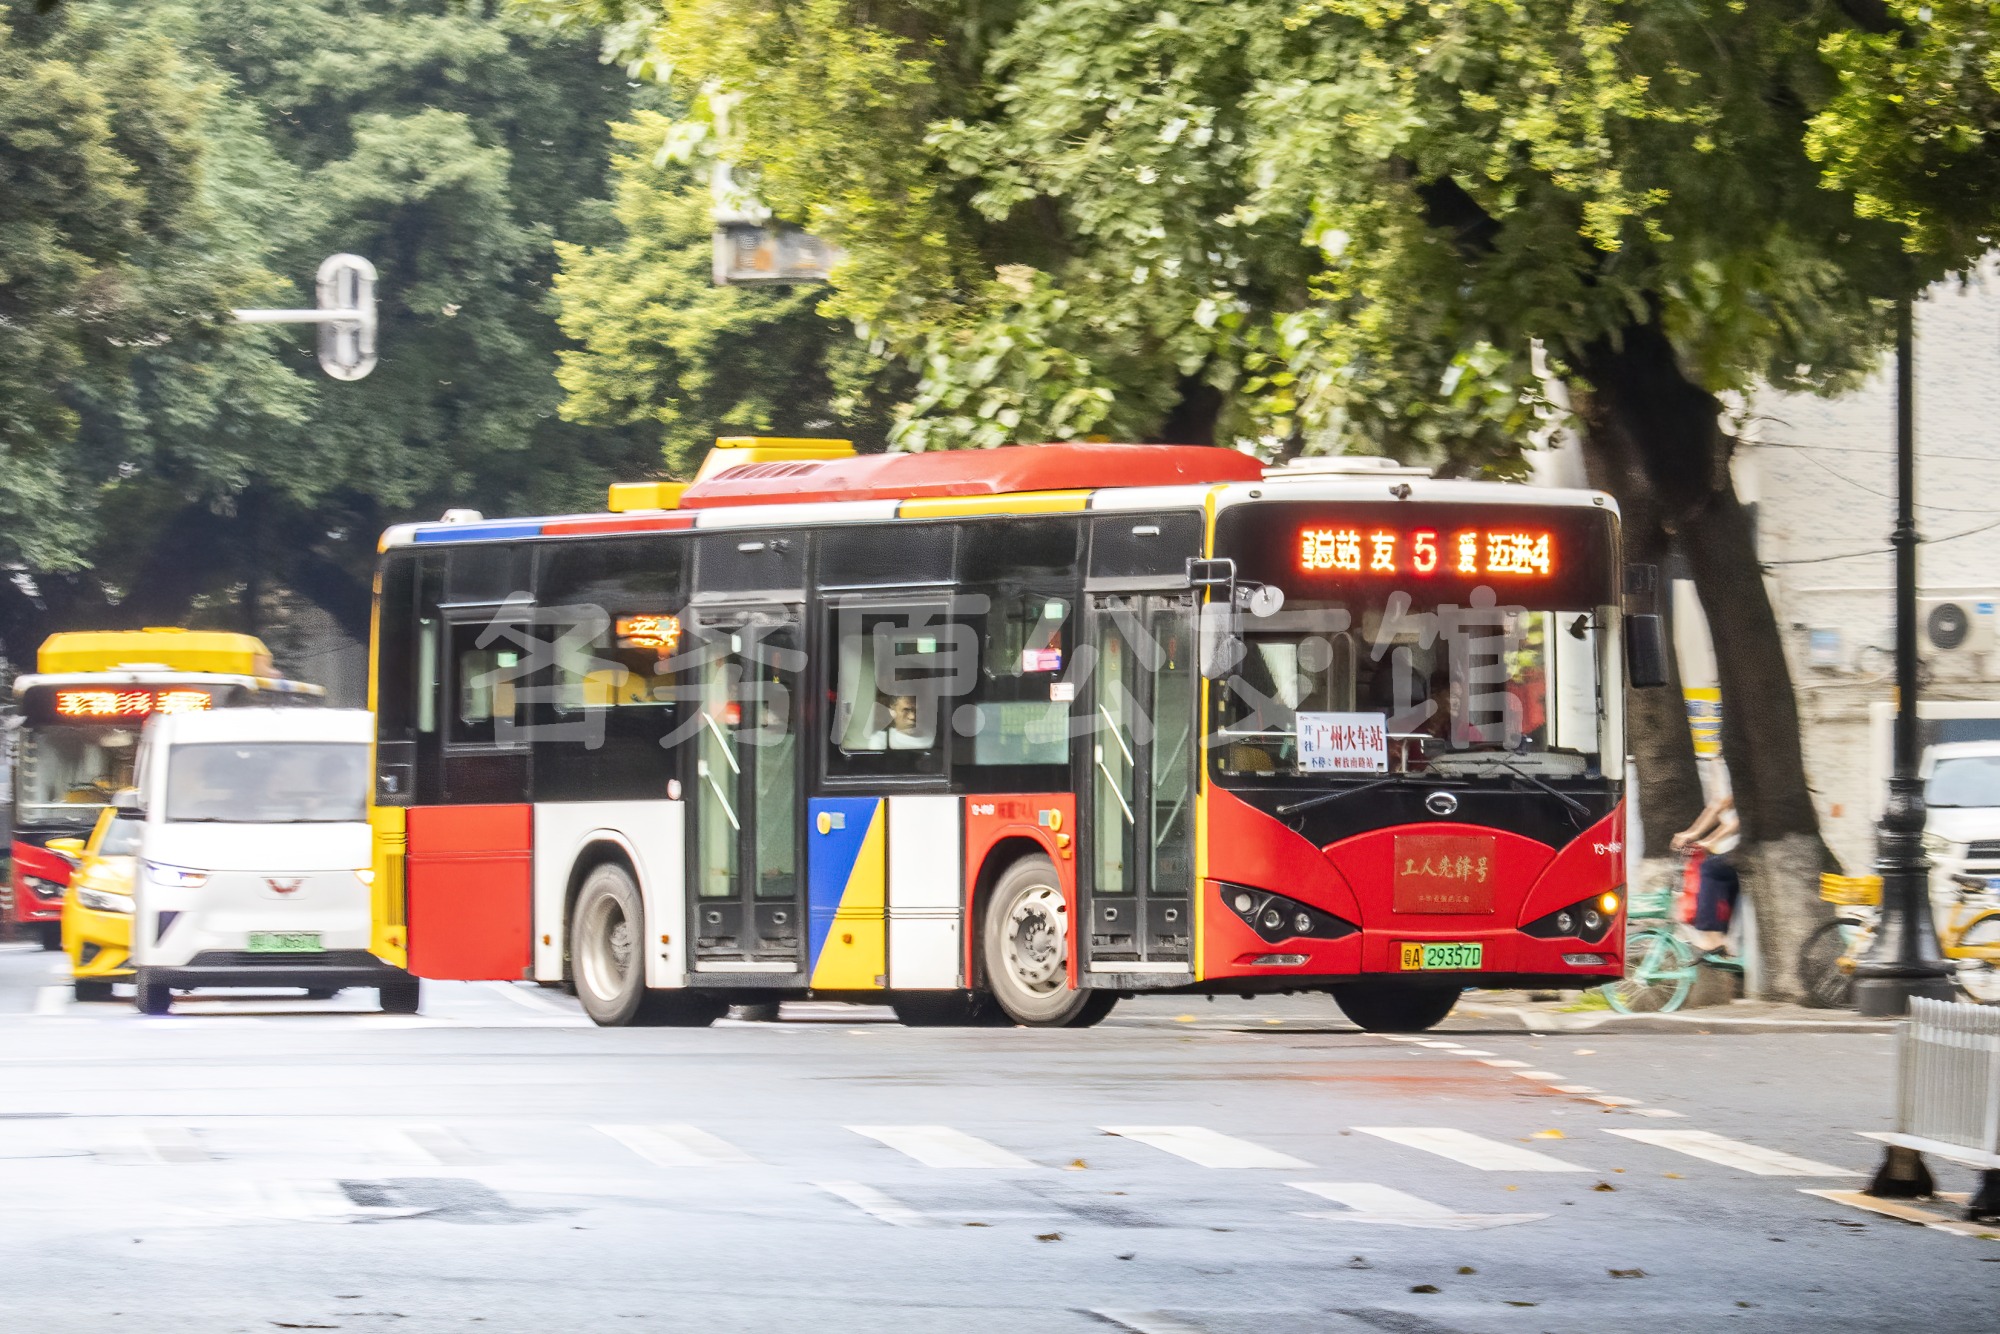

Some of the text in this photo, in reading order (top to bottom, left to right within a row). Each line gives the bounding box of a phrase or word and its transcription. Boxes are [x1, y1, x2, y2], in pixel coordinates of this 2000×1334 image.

[1414, 533, 1437, 572] 5
[1316, 725, 1384, 752] 广州火车站
[1401, 855, 1488, 883] 工人先锋号
